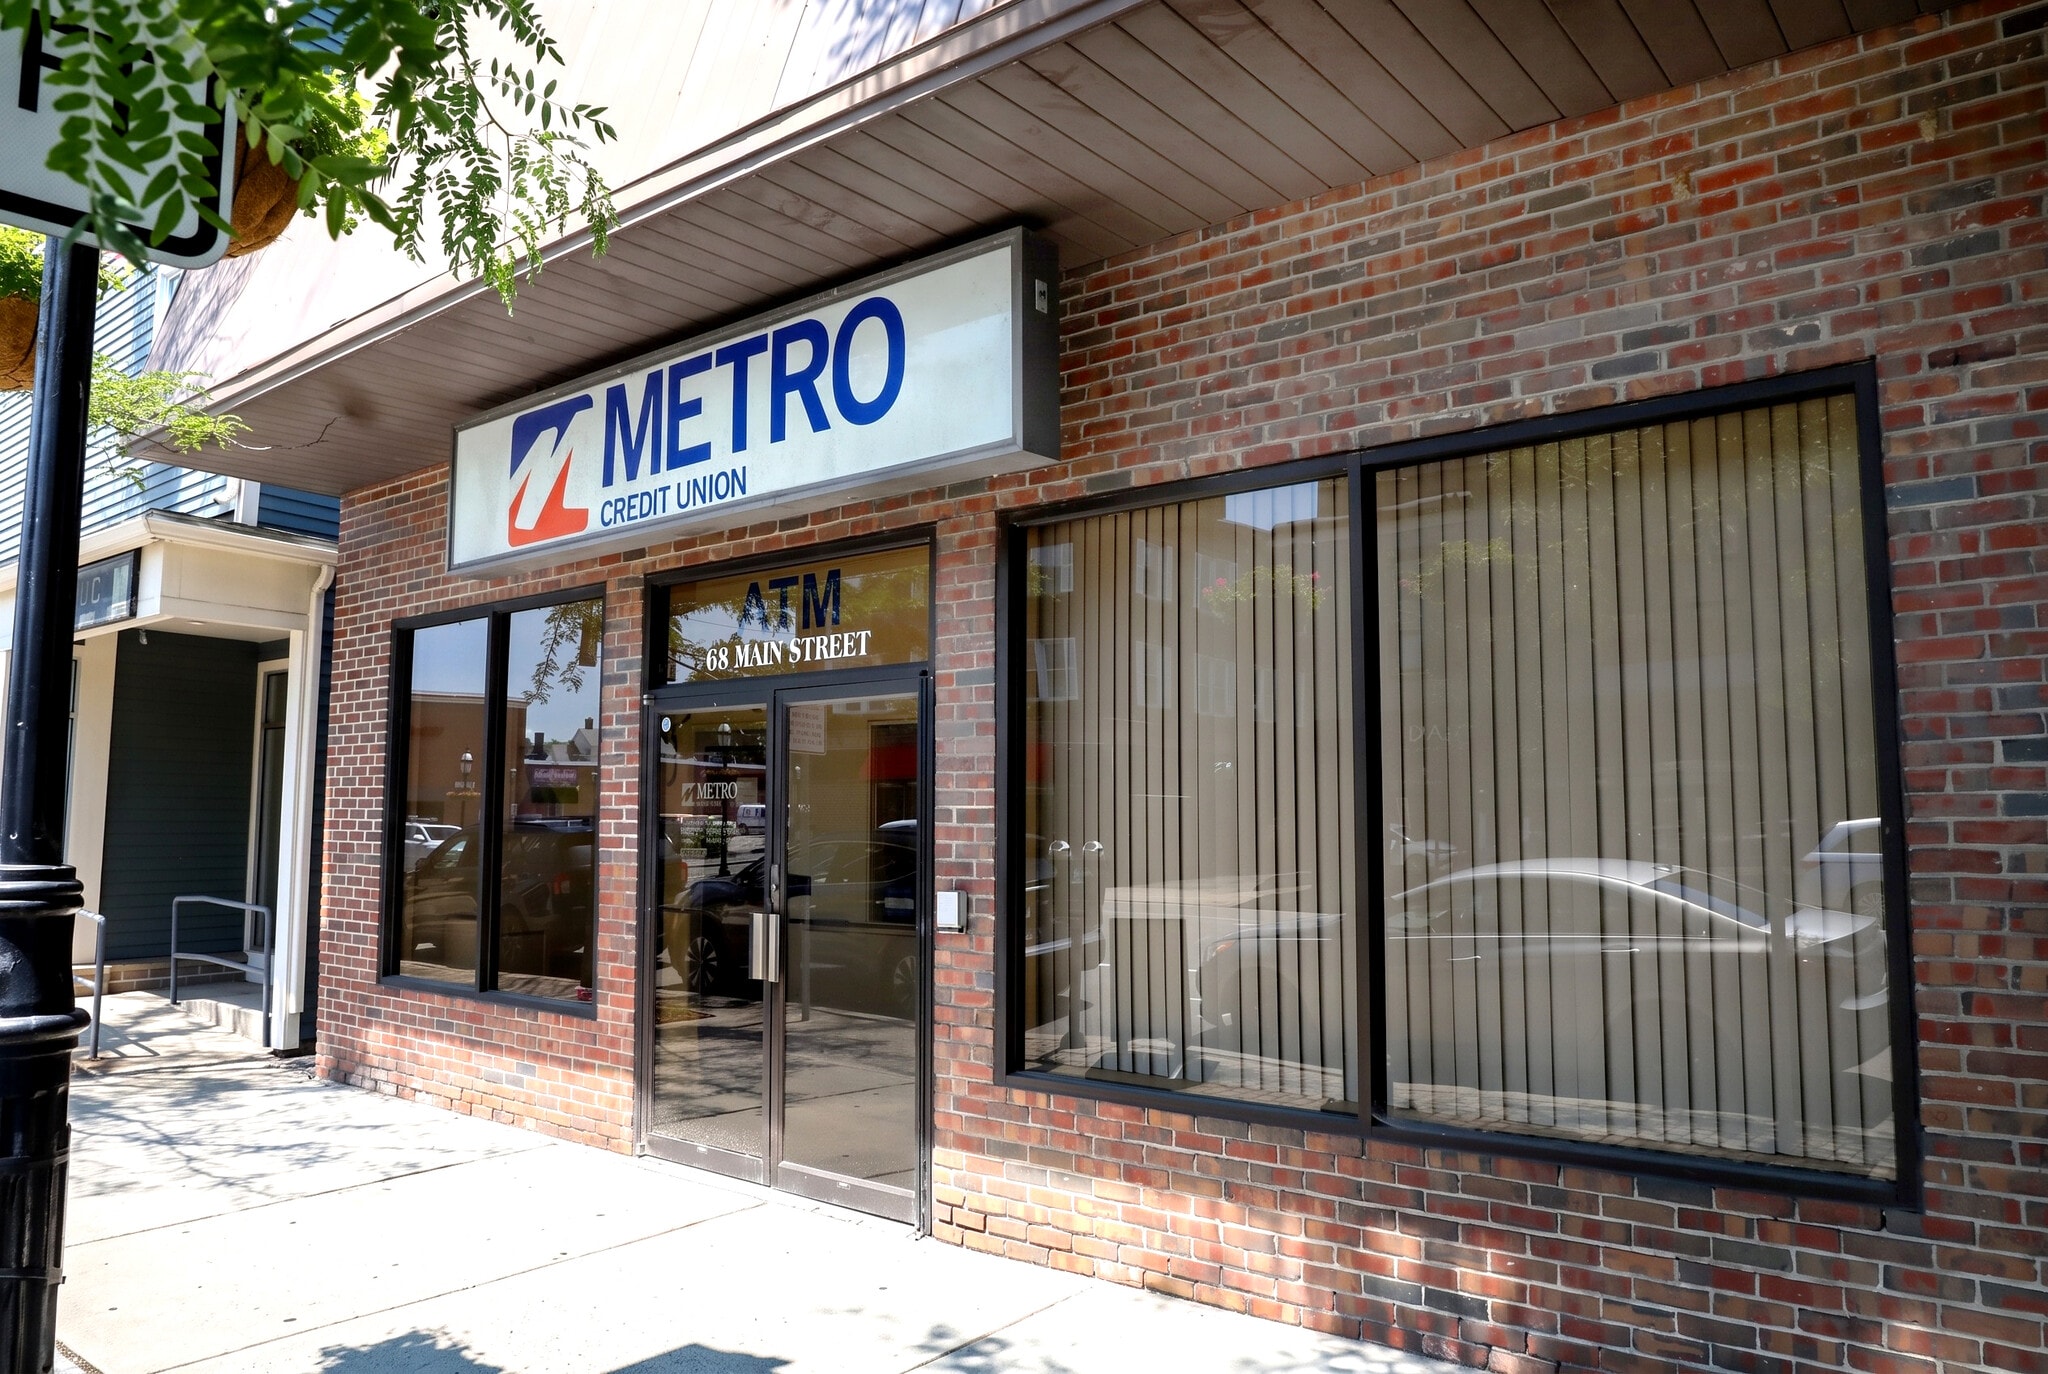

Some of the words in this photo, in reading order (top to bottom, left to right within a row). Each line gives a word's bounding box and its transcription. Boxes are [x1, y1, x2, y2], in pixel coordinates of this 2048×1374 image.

[602, 296, 906, 488] METRO
[600, 485, 671, 527] CREDIT
[677, 466, 746, 509] UNION
[736, 568, 841, 637] ATM
[706, 646, 729, 672] 68
[733, 640, 784, 669] MAIN
[788, 630, 872, 664] STREET
[697, 781, 738, 800] METRO
